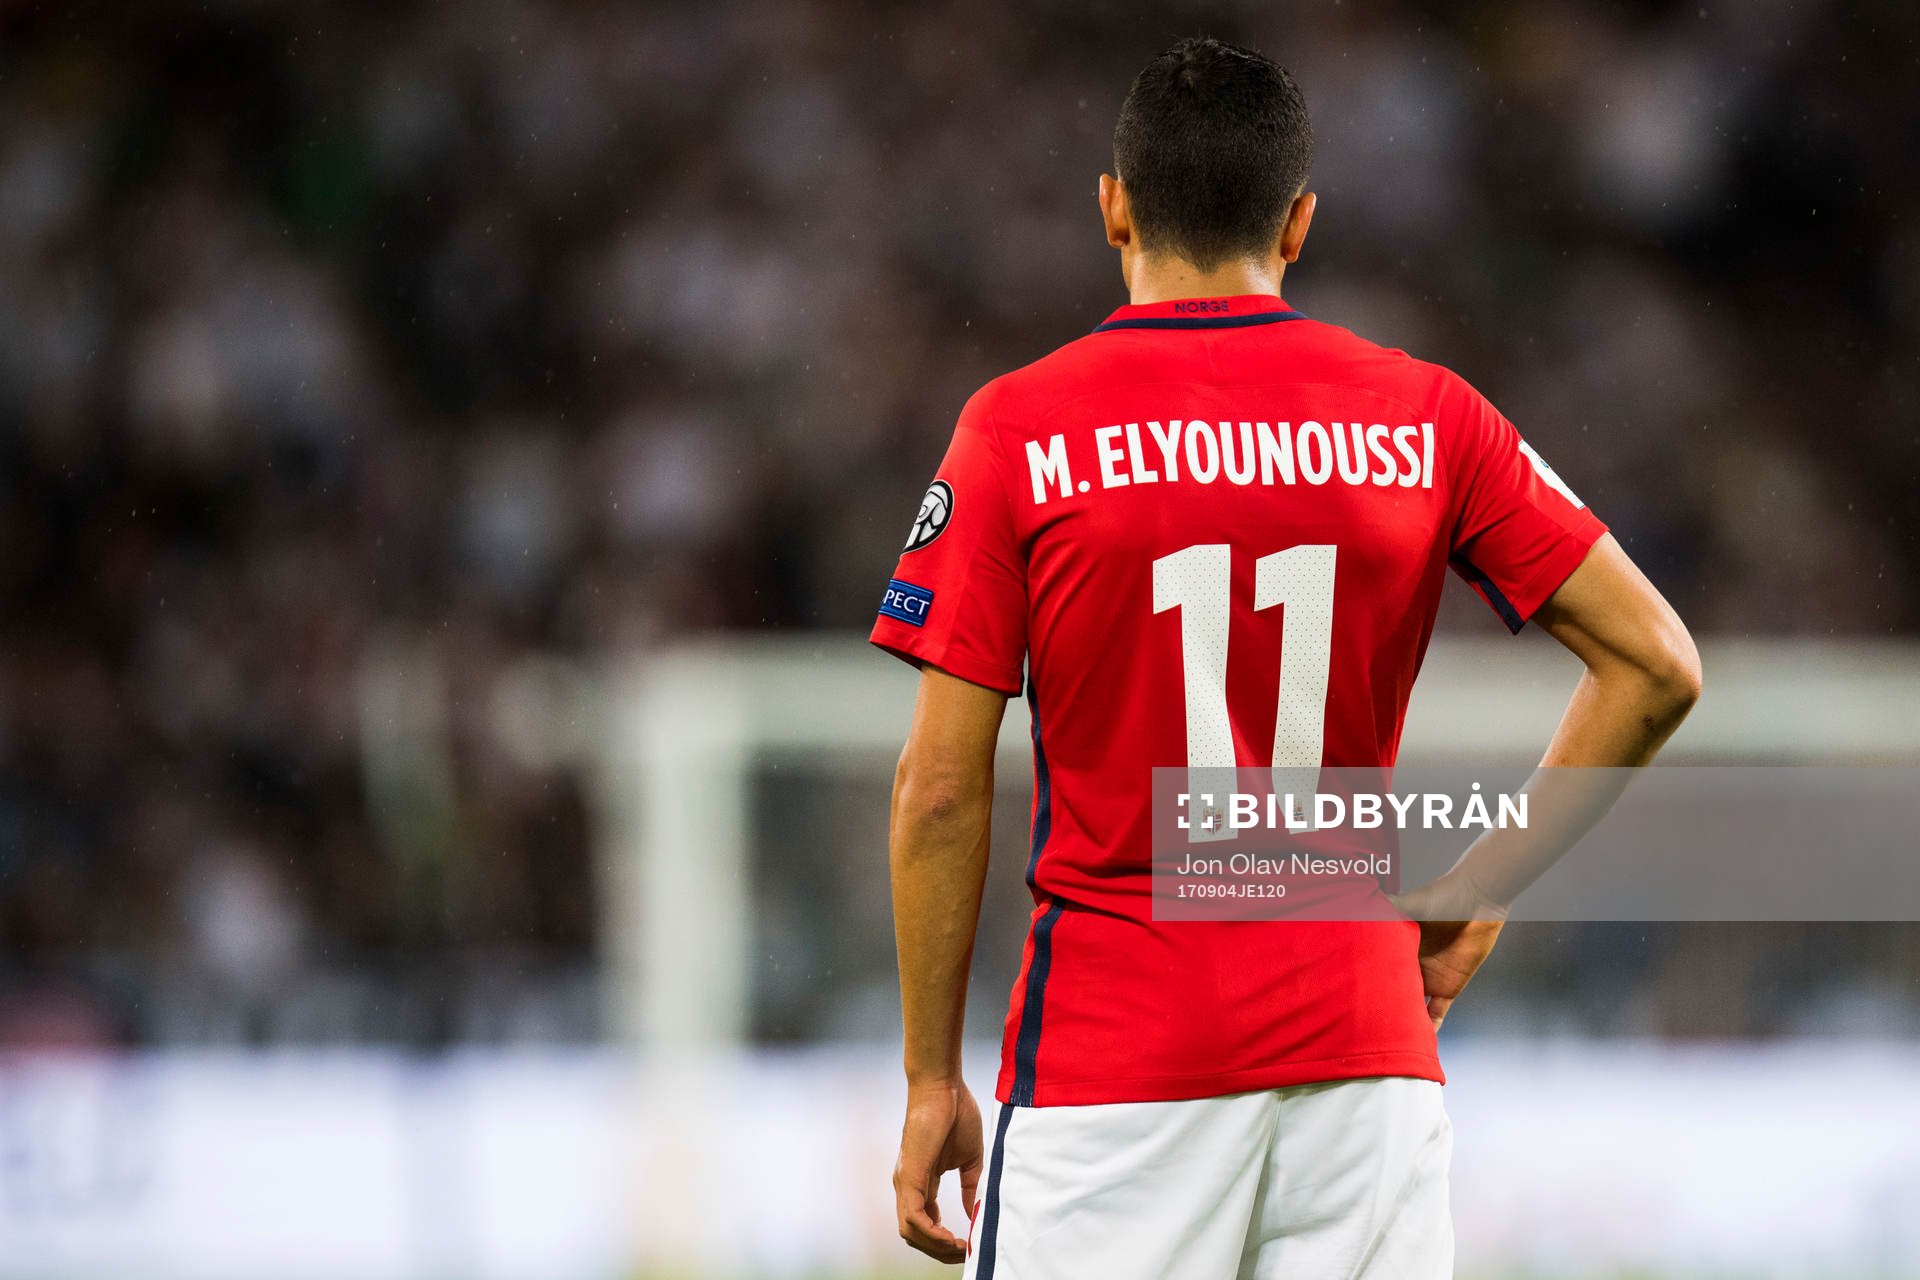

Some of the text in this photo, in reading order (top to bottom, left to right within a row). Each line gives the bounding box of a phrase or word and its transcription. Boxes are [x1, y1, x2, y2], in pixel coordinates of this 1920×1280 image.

[1175, 301, 1229, 313] NORGE
[1025, 420, 1435, 504] M. ELYOUNOUSSI
[1153, 544, 1337, 843] 11
